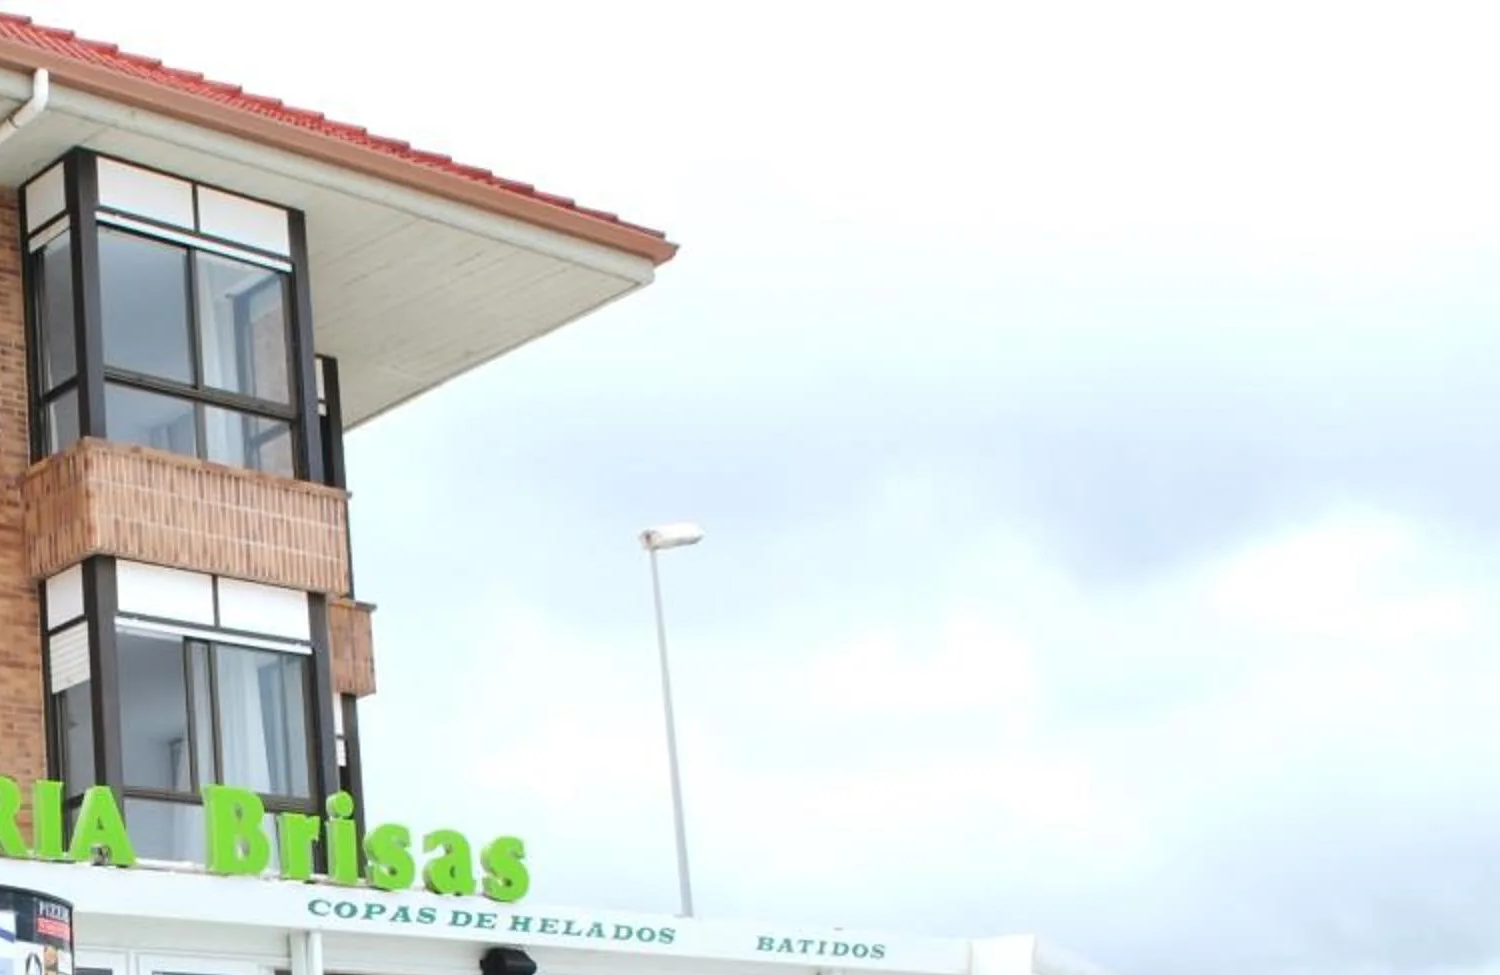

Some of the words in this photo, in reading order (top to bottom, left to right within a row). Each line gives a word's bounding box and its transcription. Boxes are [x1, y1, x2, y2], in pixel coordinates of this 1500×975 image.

[203, 782, 530, 903] Brisas
[307, 899, 437, 925] COPAS
[448, 910, 498, 929] DE
[507, 915, 677, 944] HELADOS
[756, 935, 886, 959] BATIDOS
